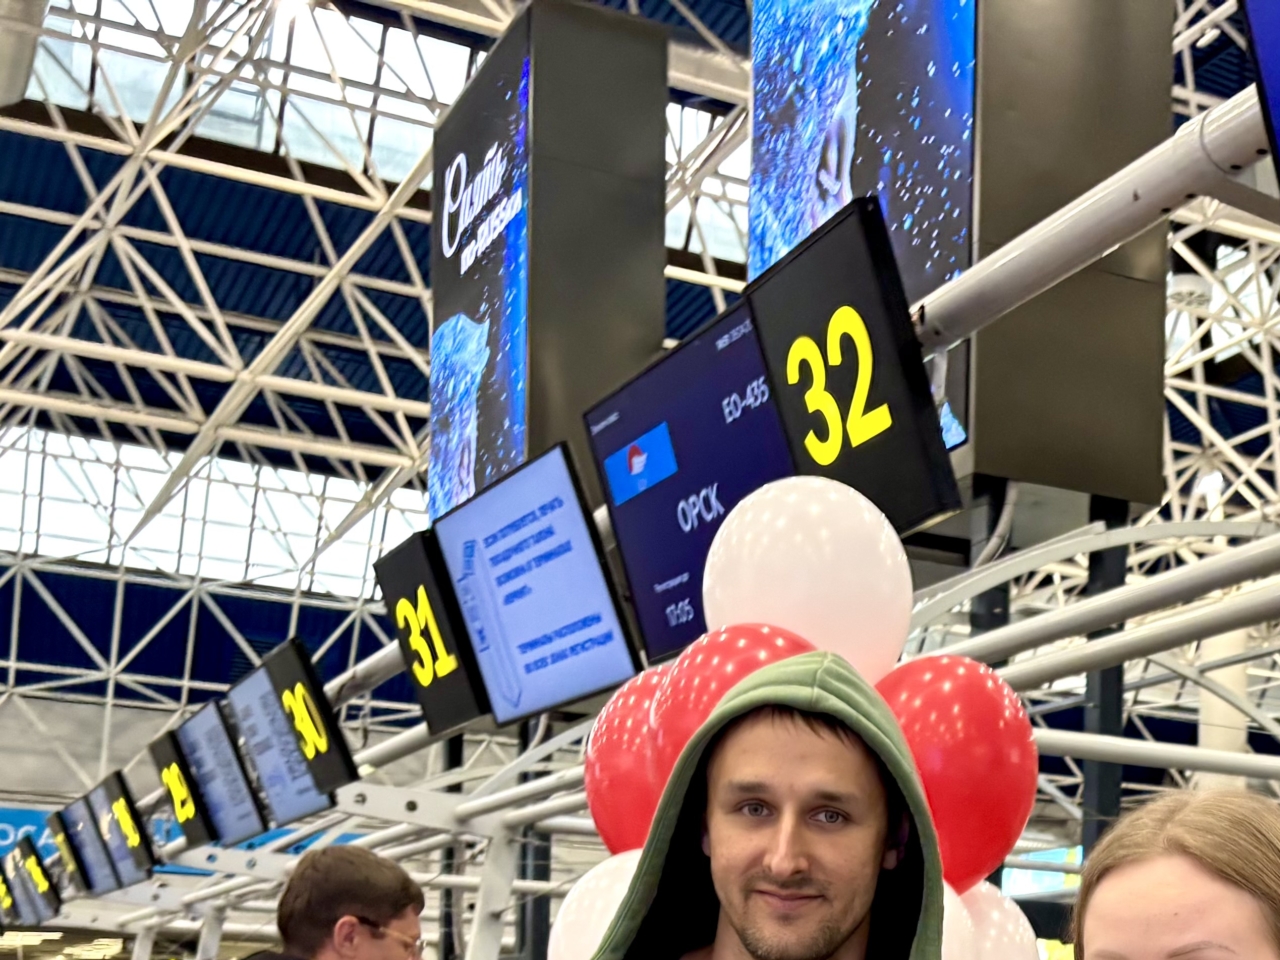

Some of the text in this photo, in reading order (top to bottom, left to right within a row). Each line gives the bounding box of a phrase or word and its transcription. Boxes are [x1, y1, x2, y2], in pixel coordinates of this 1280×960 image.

[786, 305, 893, 466] 32
[677, 482, 725, 533] ОРСК
[396, 584, 458, 687] 31
[282, 682, 328, 760] 30
